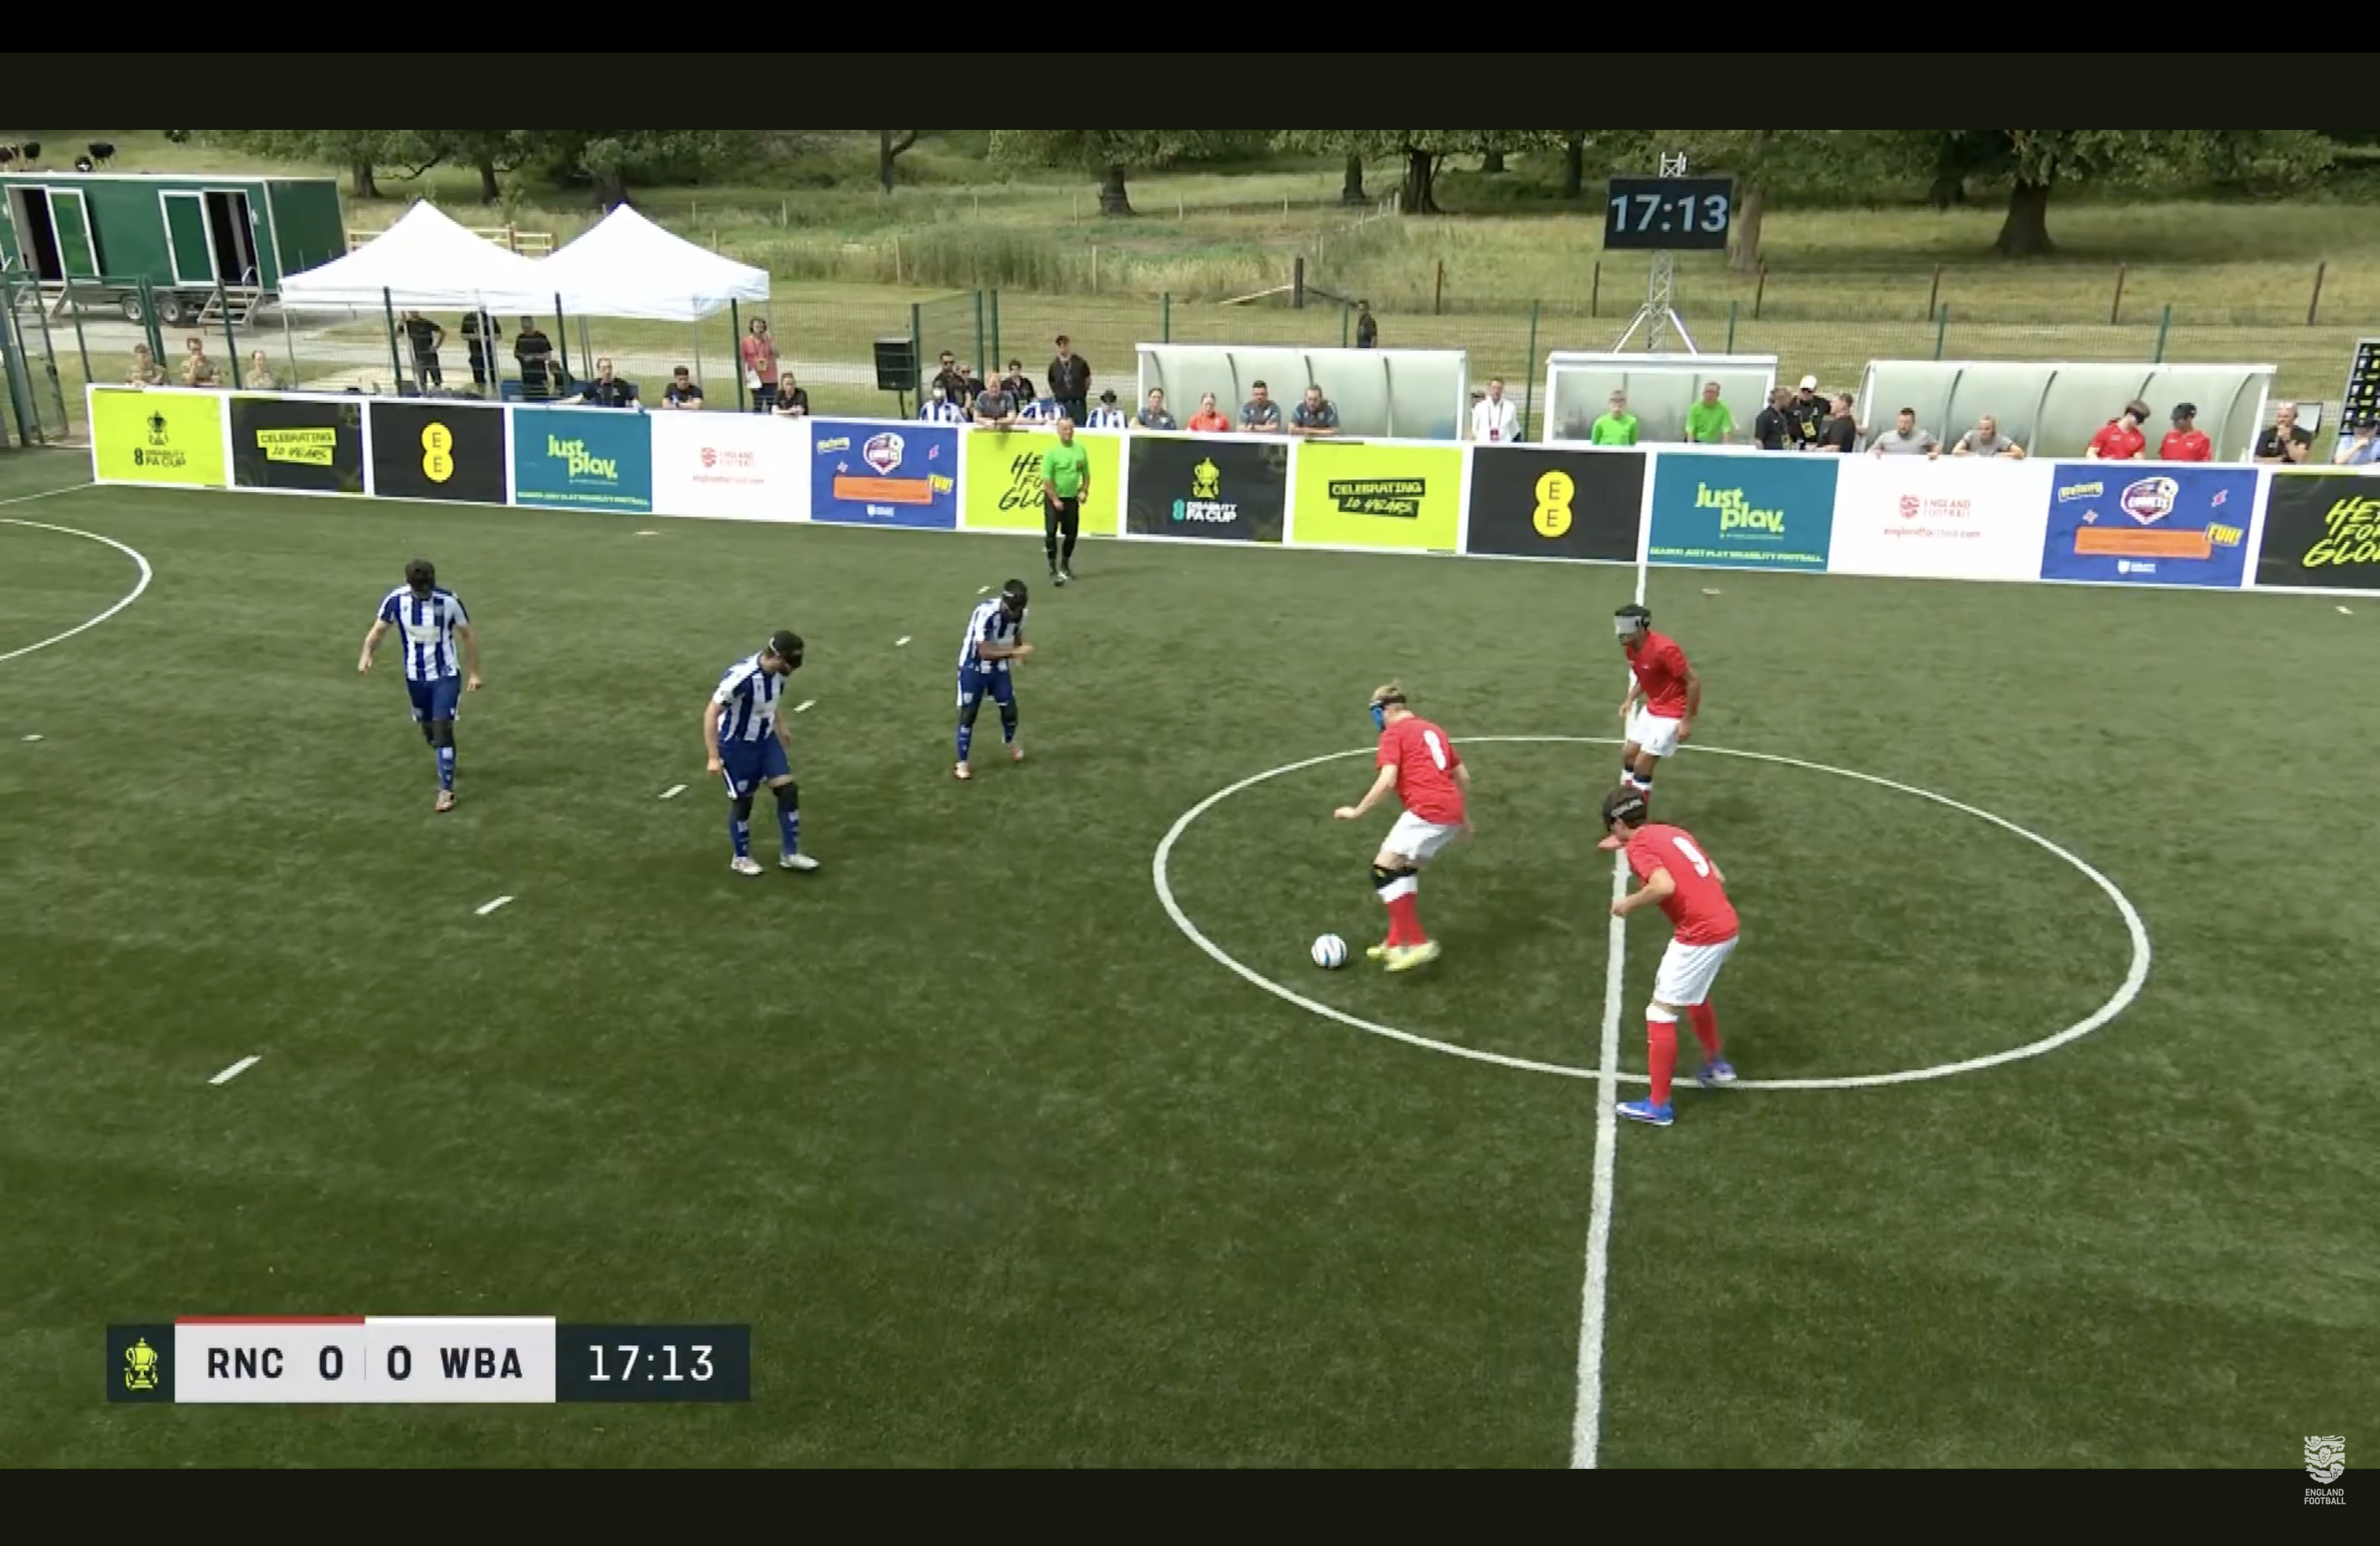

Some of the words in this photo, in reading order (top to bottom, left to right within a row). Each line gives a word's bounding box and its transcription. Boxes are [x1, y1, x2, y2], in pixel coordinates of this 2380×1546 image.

[1611, 194, 1728, 232] 17:13
[260, 432, 332, 443] CELEBRATING
[1011, 452, 1043, 485] HE
[1018, 474, 1044, 492] FO
[1331, 481, 1423, 496] CELEBRATING
[998, 486, 1045, 511] GLO
[1344, 497, 1362, 508] 10
[1363, 499, 1414, 514] YEARS
[1694, 482, 1744, 508] just
[1186, 510, 1205, 520] FA
[1206, 512, 1237, 523] CUP
[2303, 538, 2380, 567] GLO
